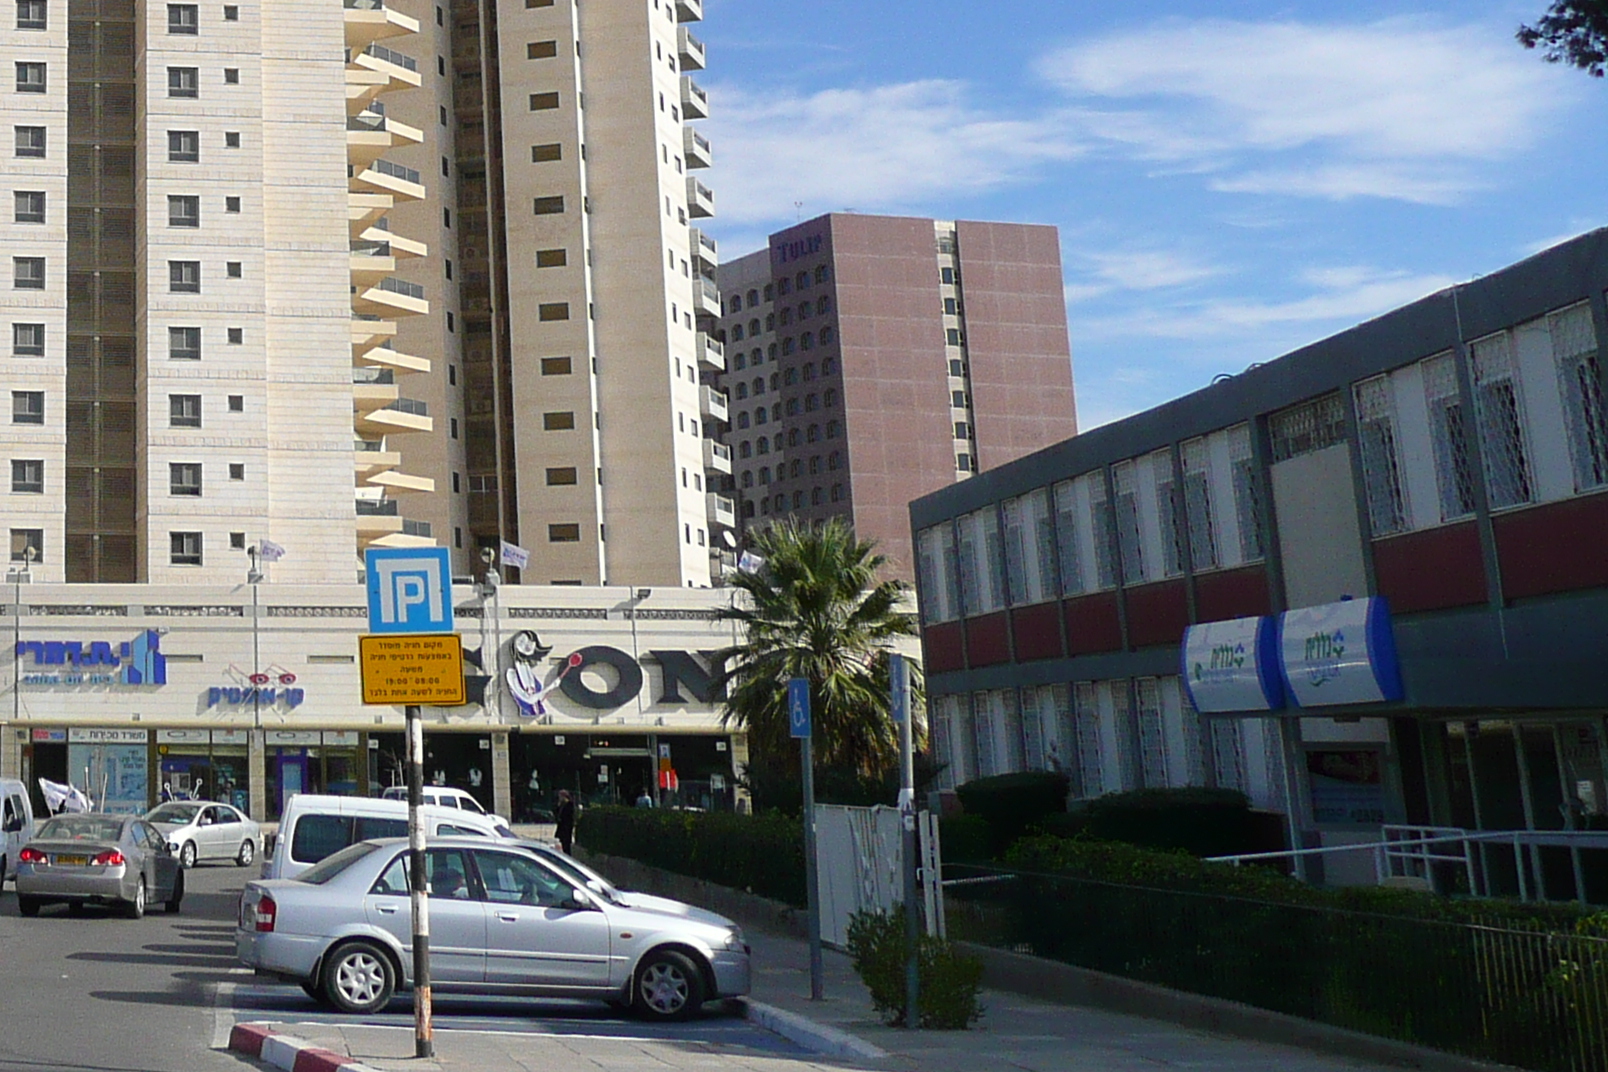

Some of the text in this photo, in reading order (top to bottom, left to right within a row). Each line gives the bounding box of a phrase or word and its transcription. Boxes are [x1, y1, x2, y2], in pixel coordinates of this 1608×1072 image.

[777, 234, 822, 262] TULIP
[403, 641, 421, 649] חניה
[423, 641, 443, 649] מקום
[89, 730, 146, 740] משרד מכירות
